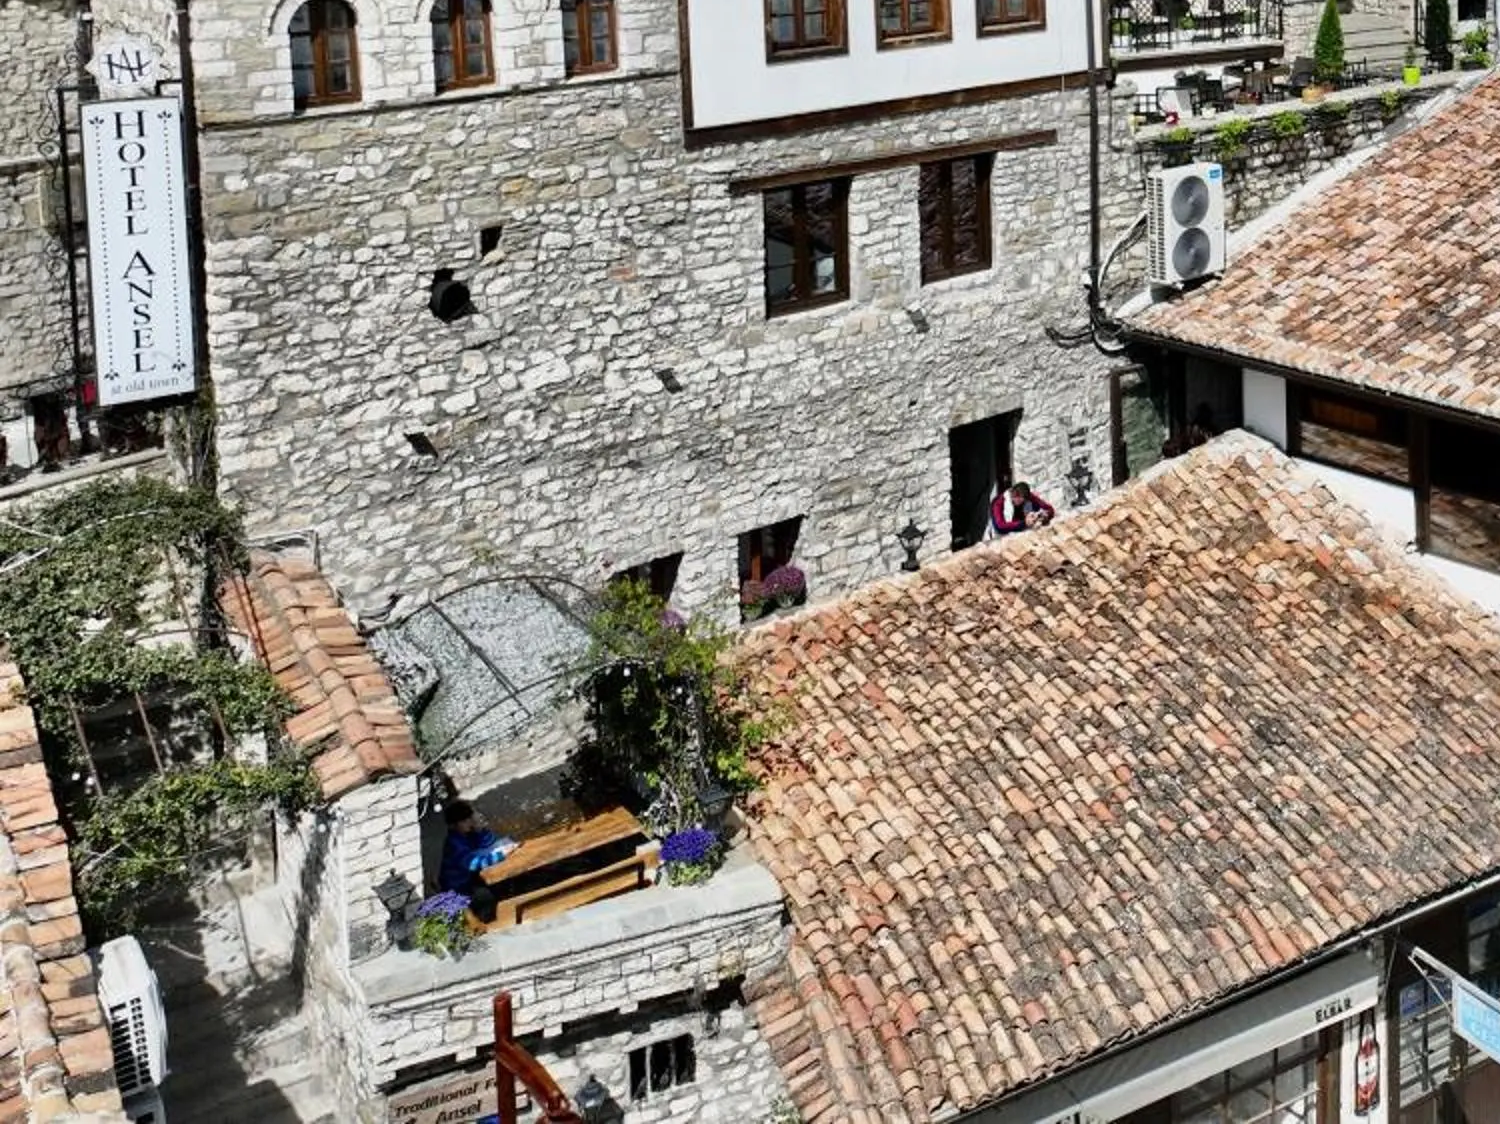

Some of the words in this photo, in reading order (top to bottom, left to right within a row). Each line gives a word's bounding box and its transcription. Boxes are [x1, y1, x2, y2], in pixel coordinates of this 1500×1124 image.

[112, 110, 150, 236] HOTEL
[123, 250, 156, 373] ANSEL
[125, 378, 145, 391] old
[395, 1083, 478, 1117] Traditional
[436, 1099, 482, 1124] Ansel
